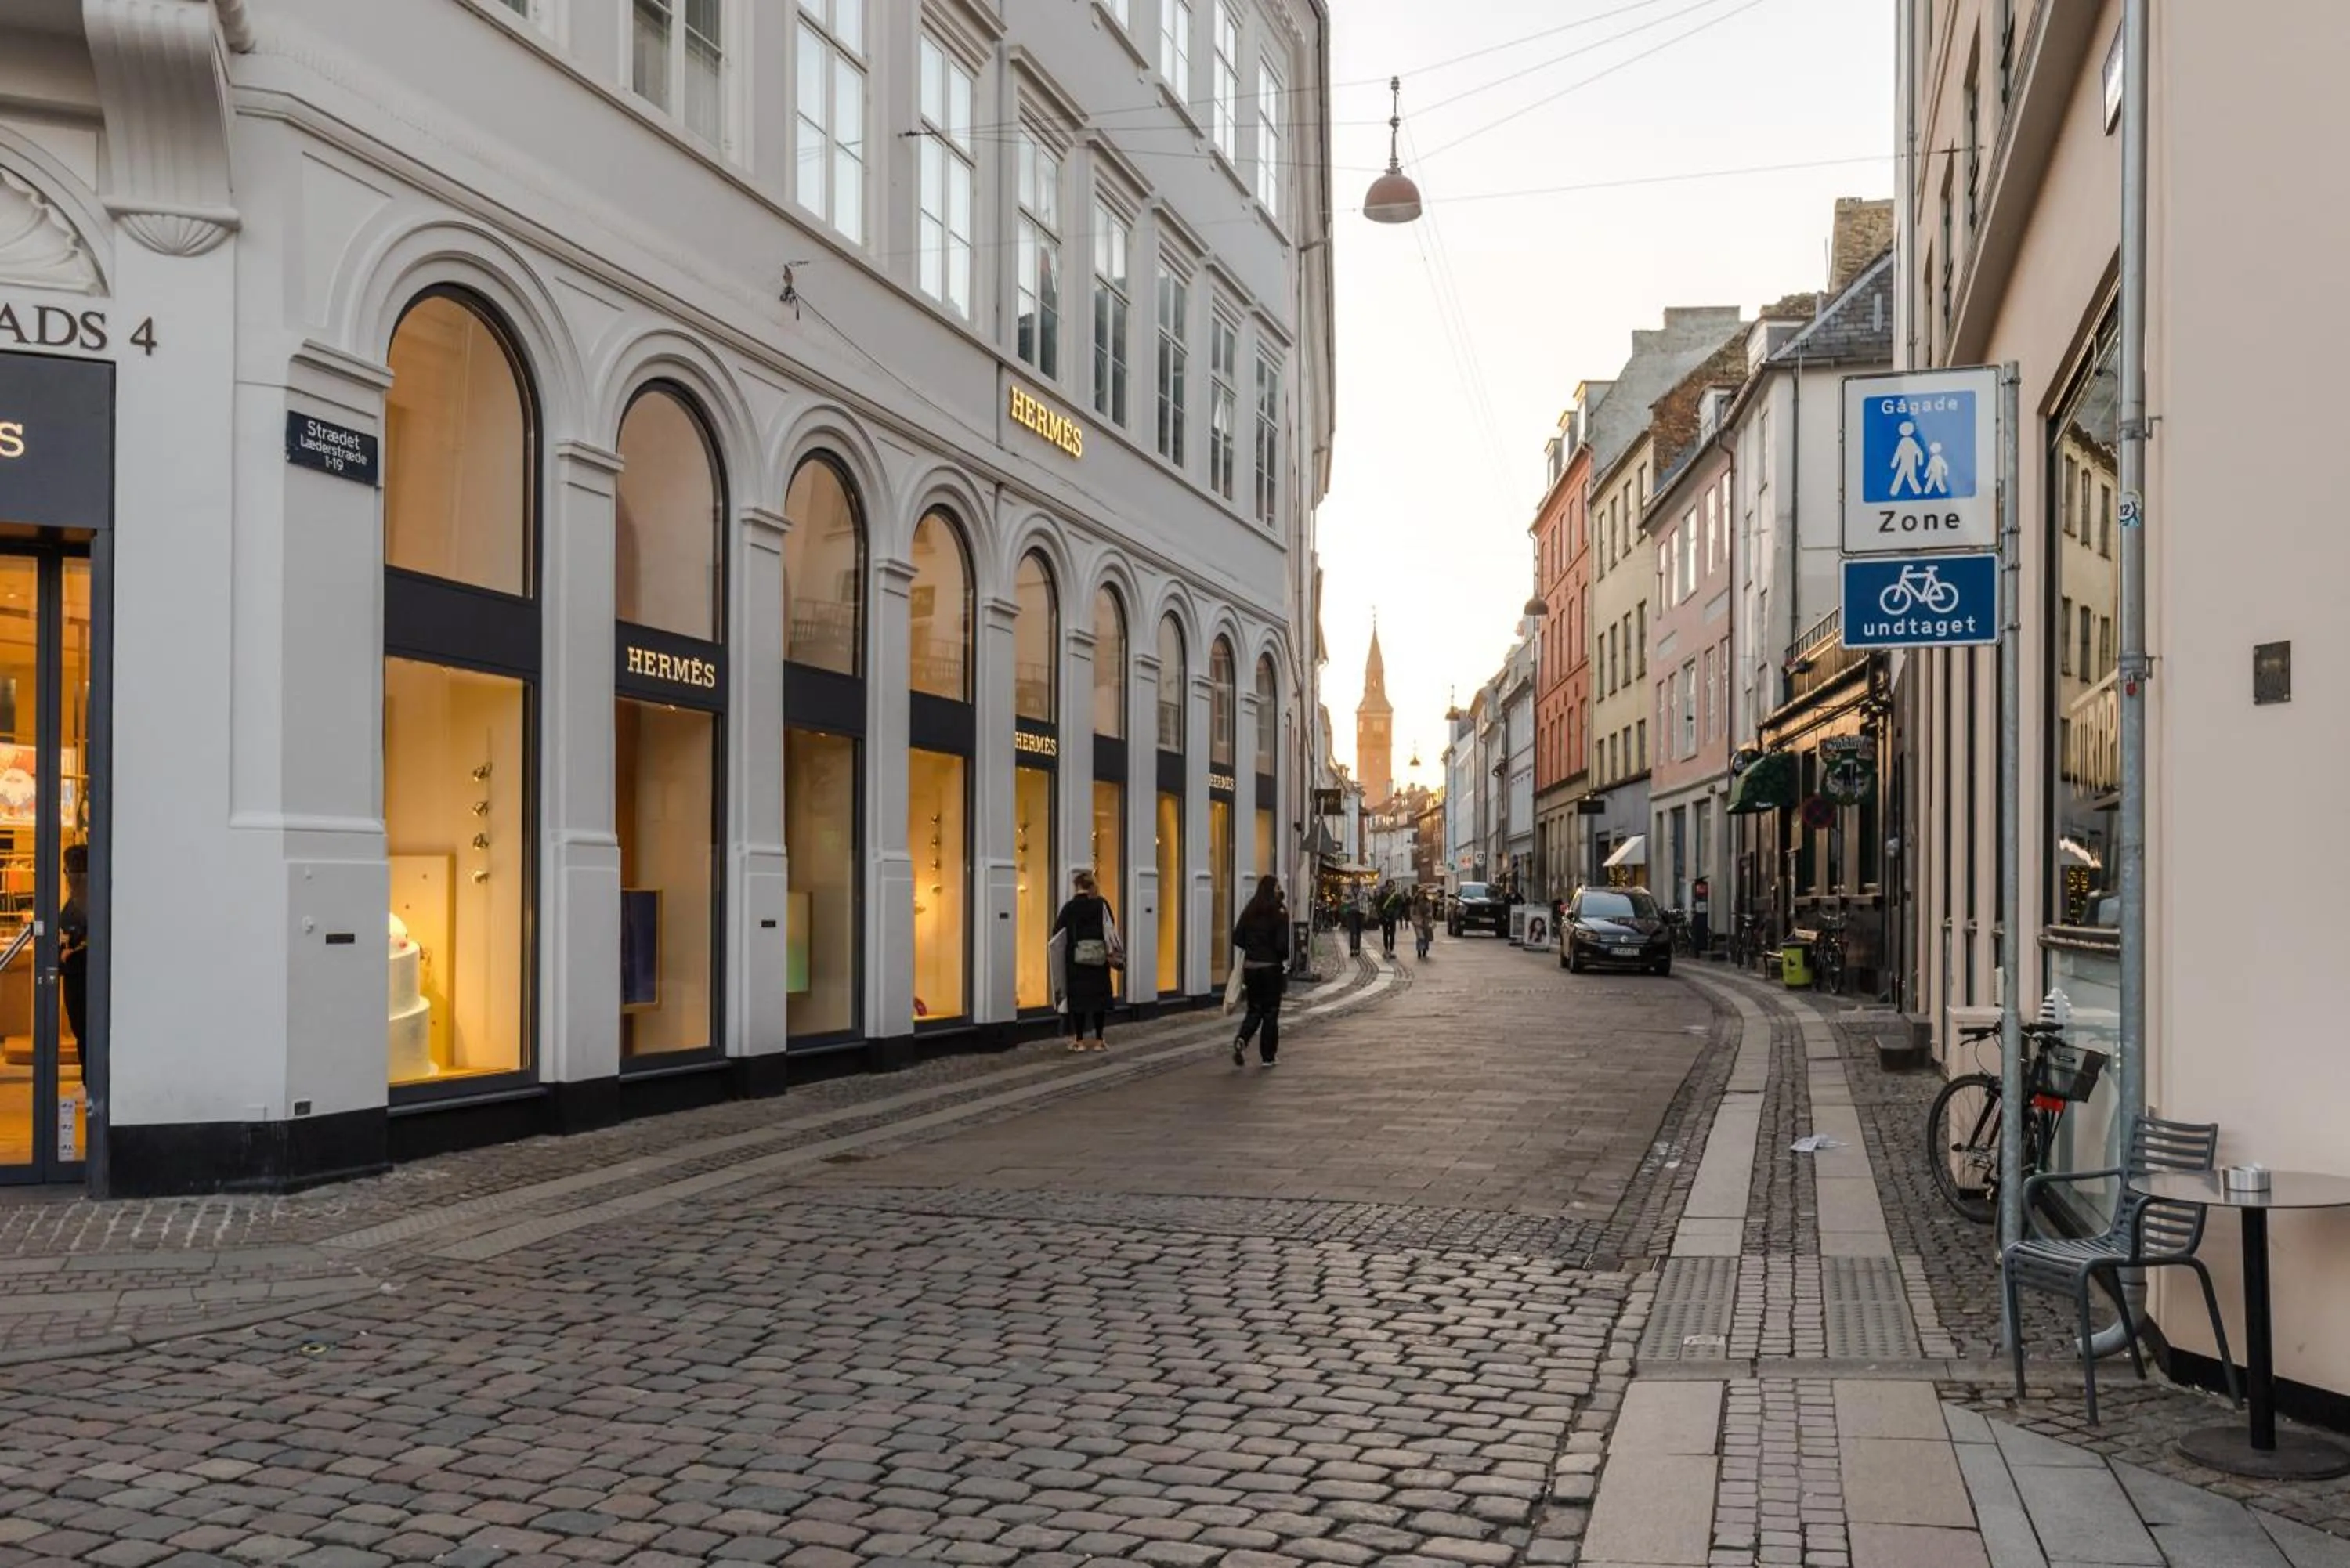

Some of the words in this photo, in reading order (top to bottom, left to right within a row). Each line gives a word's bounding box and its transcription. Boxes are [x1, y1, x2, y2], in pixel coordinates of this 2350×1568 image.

[130, 316, 157, 356] 4
[1881, 397, 1958, 416] Gågade
[307, 420, 360, 450] Strædet
[300, 433, 367, 467] Læderstræde
[325, 455, 344, 471] 1-19
[1879, 510, 1961, 533] Zone
[1864, 615, 1976, 638] undtaget
